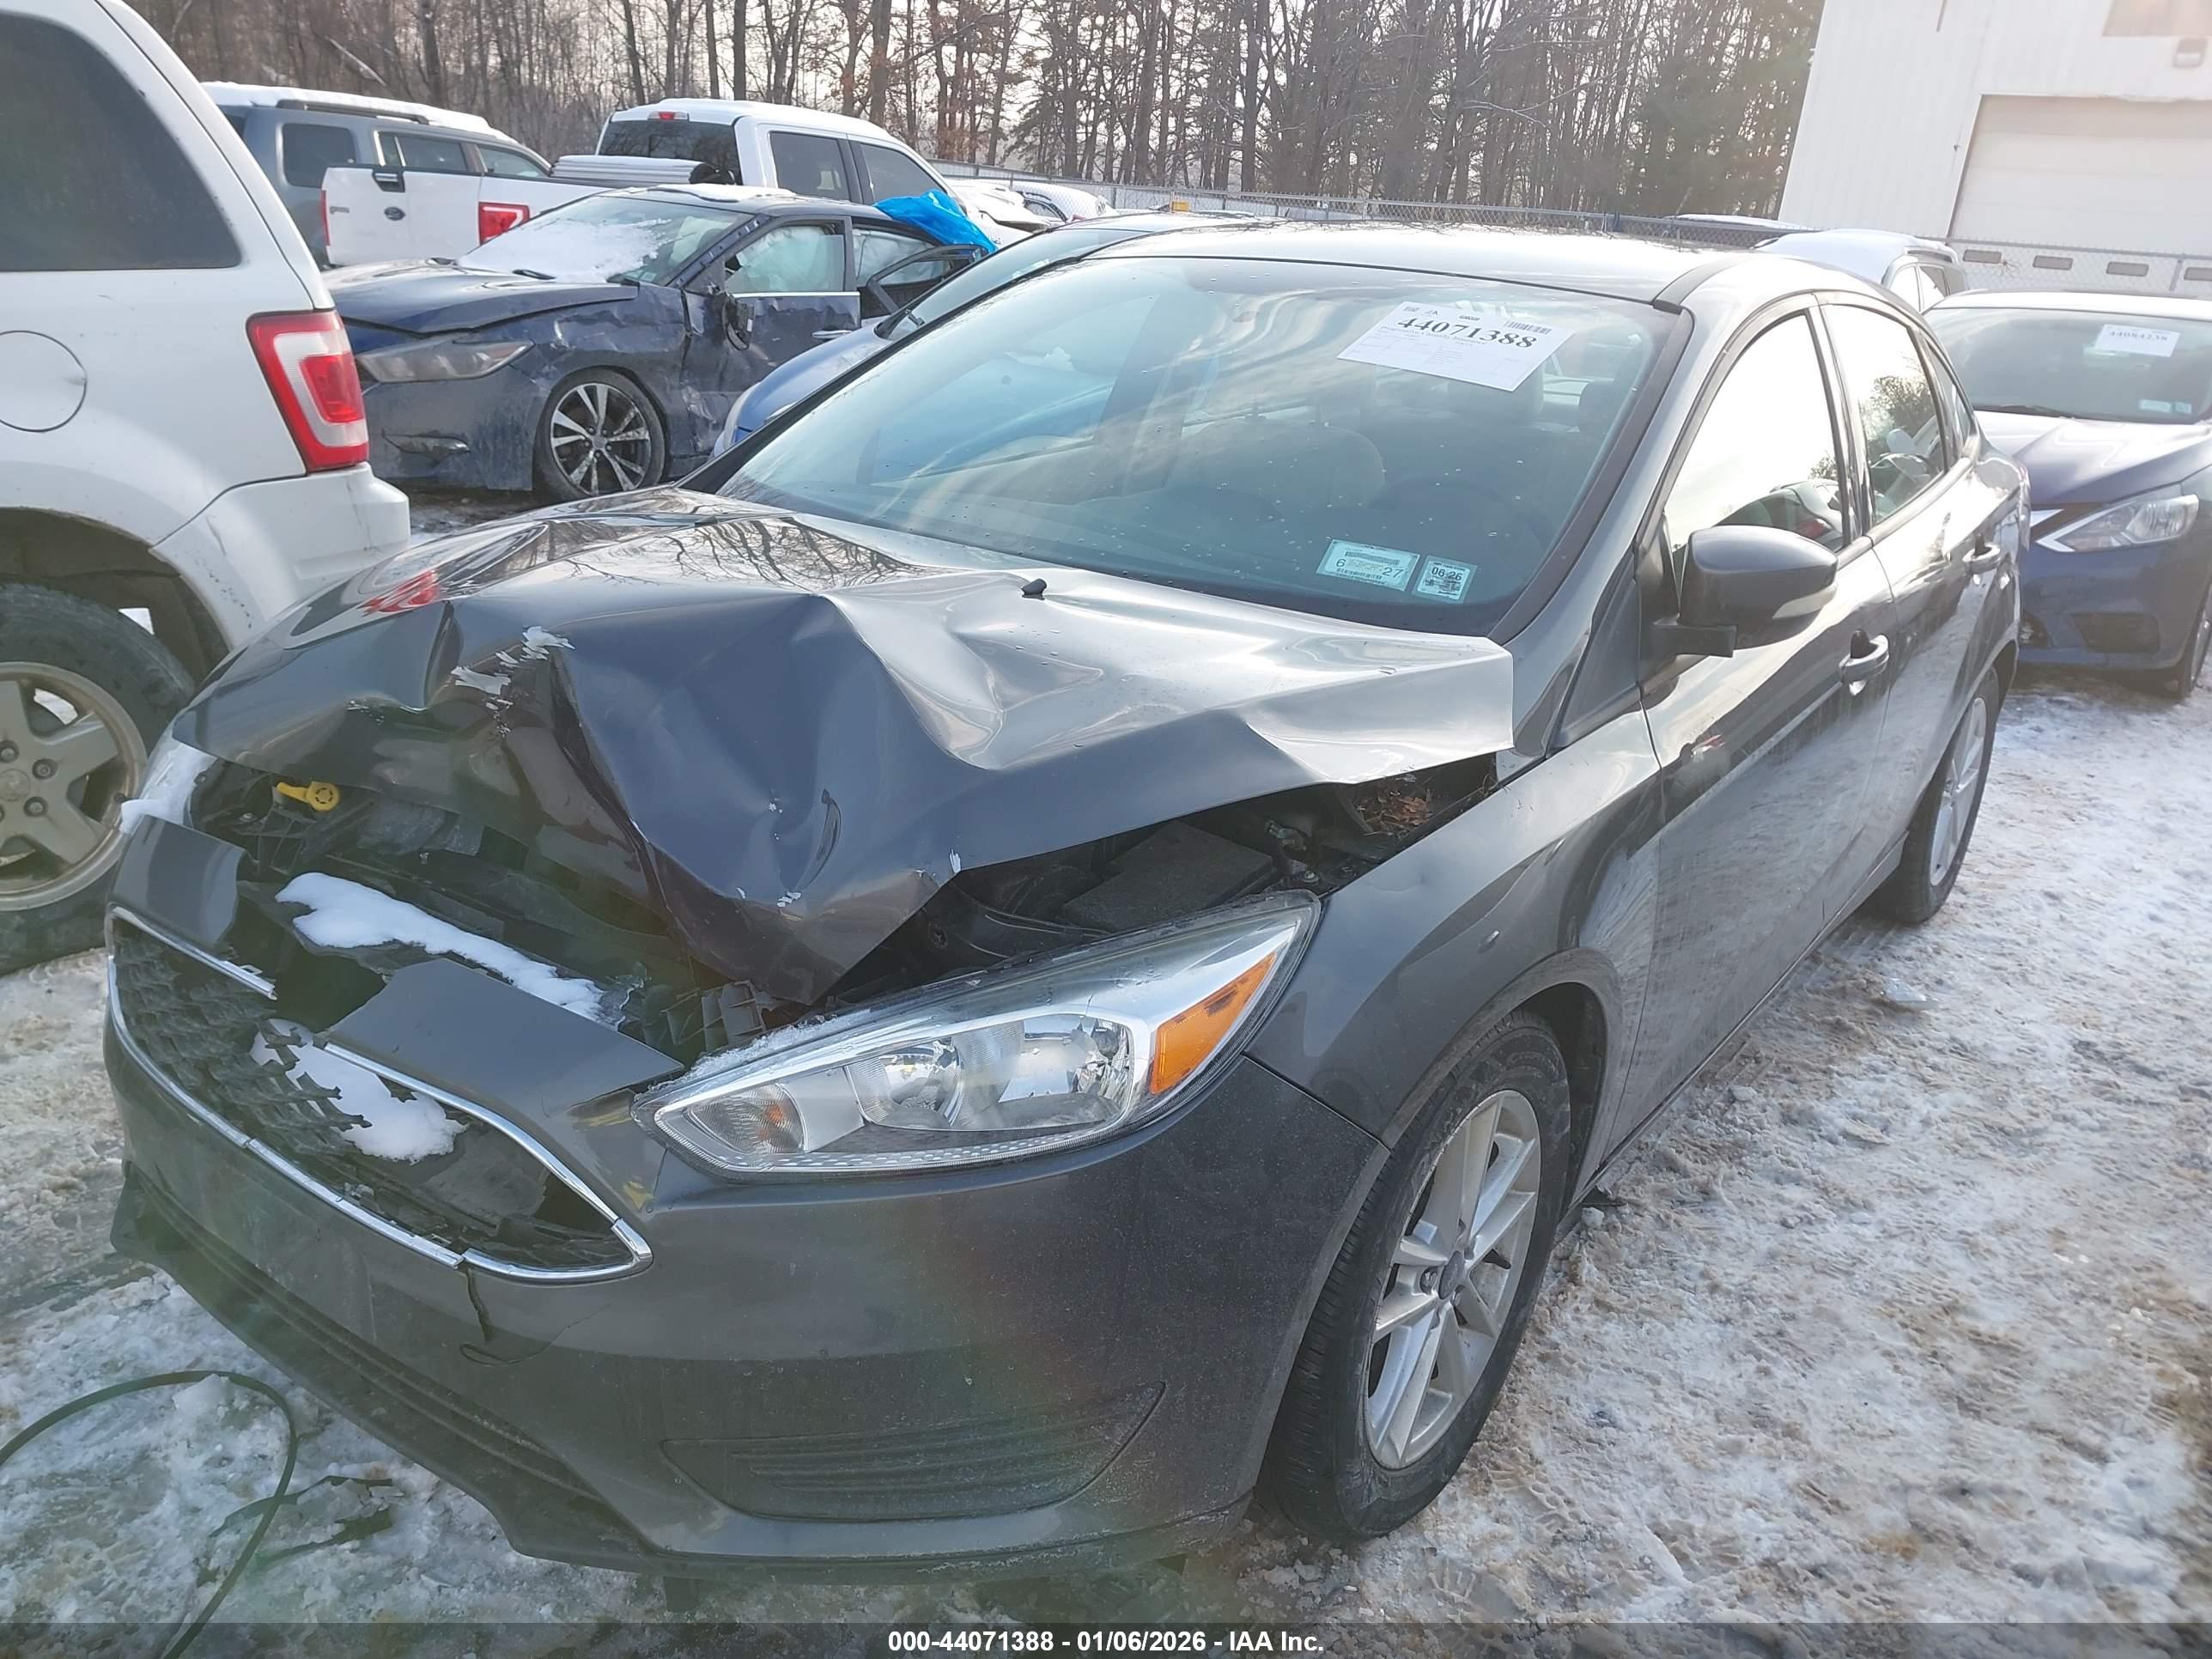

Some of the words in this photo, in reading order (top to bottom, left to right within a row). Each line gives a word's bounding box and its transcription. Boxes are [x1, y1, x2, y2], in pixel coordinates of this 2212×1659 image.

[1397, 317, 1537, 348] 44071388
[1336, 558, 1346, 568] 6
[1382, 567, 1404, 578] 27
